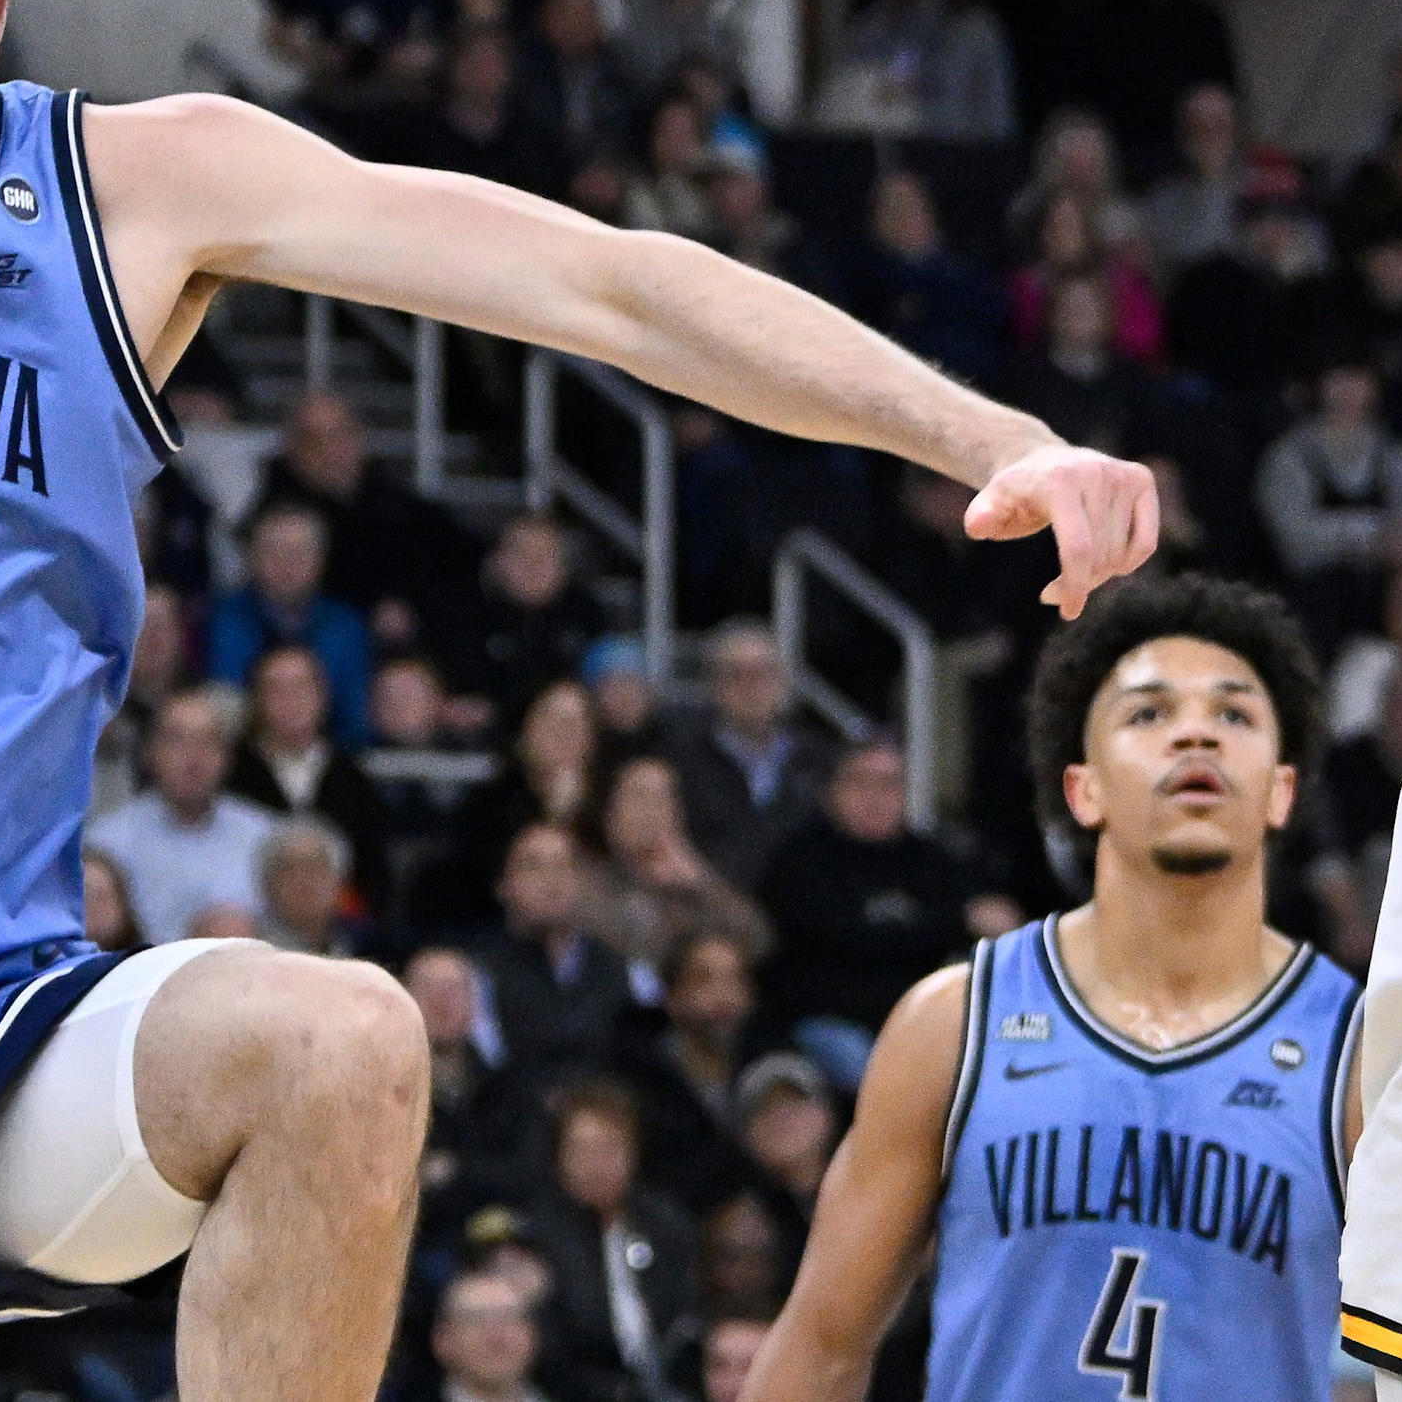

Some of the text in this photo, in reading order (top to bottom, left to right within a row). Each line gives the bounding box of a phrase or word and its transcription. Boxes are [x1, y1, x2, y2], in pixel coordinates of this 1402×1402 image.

[2, 185, 35, 213] GHR
[984, 1124, 1292, 1276] VILLANOVA
[1077, 1245, 1166, 1402] 4
